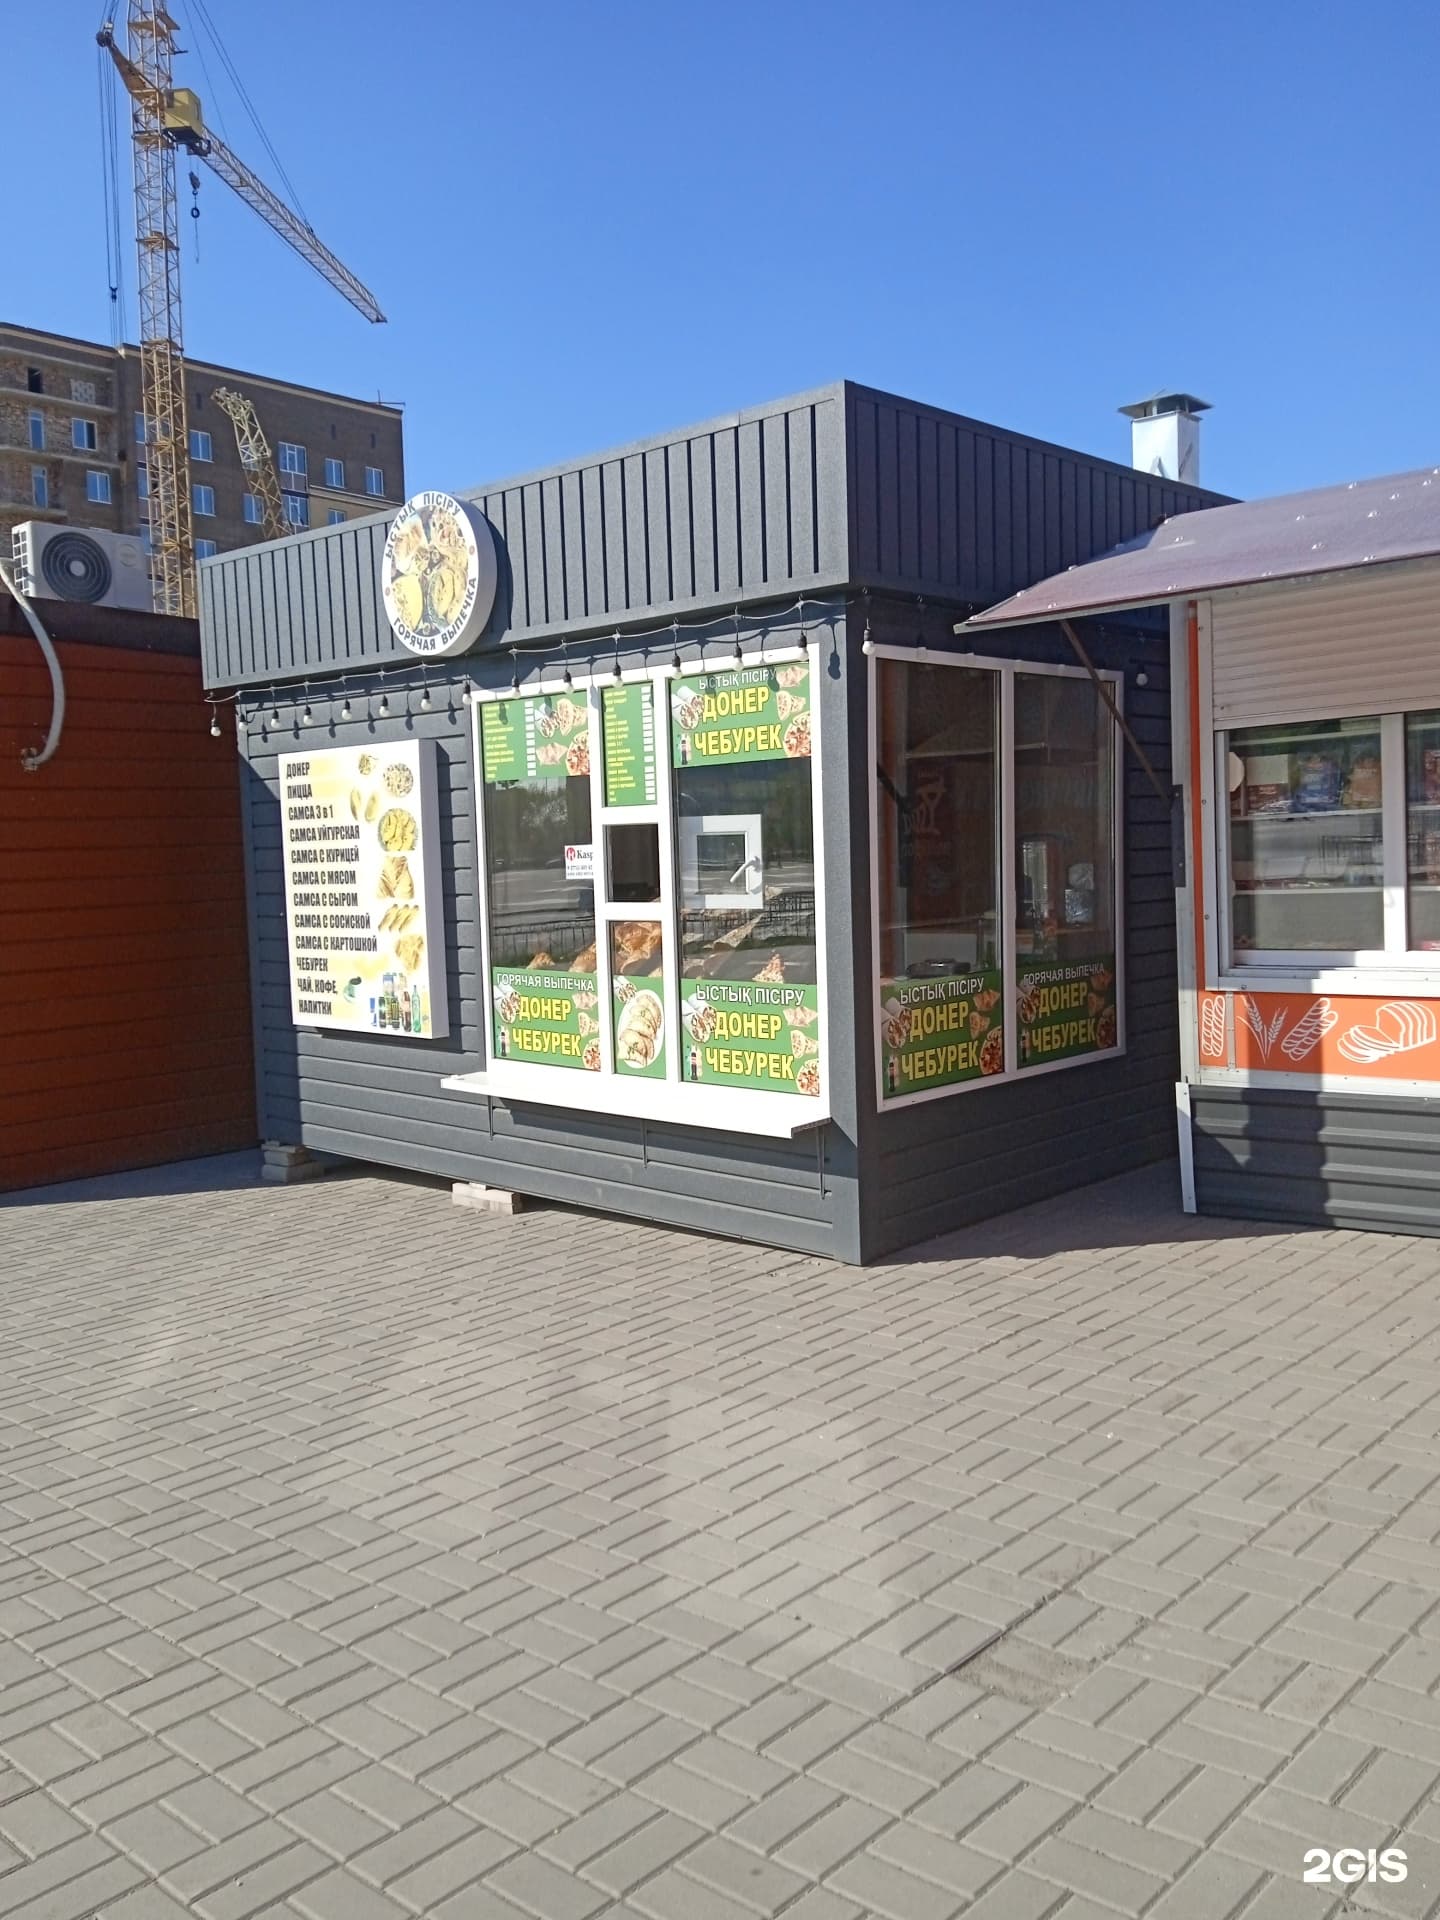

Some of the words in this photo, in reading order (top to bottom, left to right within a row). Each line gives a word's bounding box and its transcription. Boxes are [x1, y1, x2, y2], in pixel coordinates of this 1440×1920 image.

[423, 493, 461, 516] ПІСІРУ
[394, 617, 437, 651] ГОРЯЧАЯ
[442, 577, 477, 645] ВЫПЕЧКА
[742, 669, 776, 684] ПІСІРУ
[702, 686, 770, 722] ДОНЕР
[694, 724, 784, 756] ЧЕБУРЕК
[286, 762, 310, 779] ДОНЕР
[287, 784, 312, 800] ПИЦЦА
[288, 806, 315, 820] САМСА
[316, 805, 321, 819] 3
[329, 804, 334, 818] 1
[290, 828, 316, 842] САМСА
[317, 824, 360, 840] УЙГУРСКАЯ
[291, 849, 318, 863] САМСА
[320, 849, 325, 862] С
[326, 845, 359, 864] КУРИЦЕЙ
[292, 871, 320, 885] САМСА
[321, 871, 326, 885] С
[327, 870, 356, 884] МЯСОМ
[294, 892, 320, 907] САМСА
[322, 893, 327, 906] С
[329, 892, 358, 906] СЫРОМ
[295, 914, 321, 928] САМСА
[323, 915, 328, 928] С
[330, 912, 370, 929] СОСИСКОЙ
[296, 936, 322, 950] САМСА
[324, 936, 328, 950] С
[330, 935, 377, 952] КАРТОШКОЙ
[296, 957, 328, 972] ЧЕБУРЕК
[1023, 968, 1063, 986] ГОРЯЧАЯ
[1066, 964, 1104, 980] ВЫПЕЧКА
[297, 976, 314, 993] ЧАЙ,
[315, 979, 338, 995] КОФЕ,
[497, 974, 541, 989] ГОРЯЧАЯ
[544, 976, 594, 992] ВЫПЕЧКА
[900, 982, 945, 1005] ЫСТЫҚ
[949, 977, 984, 998] ПІСІРУ
[299, 1000, 332, 1015] НАПИТКИ
[696, 985, 752, 1008] ЫСТЫҚ
[755, 988, 805, 1006] ПІСІРУ
[1039, 982, 1088, 1018] ДОНЕР
[518, 996, 572, 1021] ДОНЕР
[715, 1011, 782, 1041] ДОНЕР
[909, 1001, 969, 1042] ДОНЕР
[512, 1028, 582, 1056] ЧЕБУРЕК
[1031, 1018, 1096, 1053] ЧЕБУРЕК
[706, 1047, 795, 1080] ЧЕБУРЕК
[901, 1040, 979, 1081] ЧЕБУРЕК
